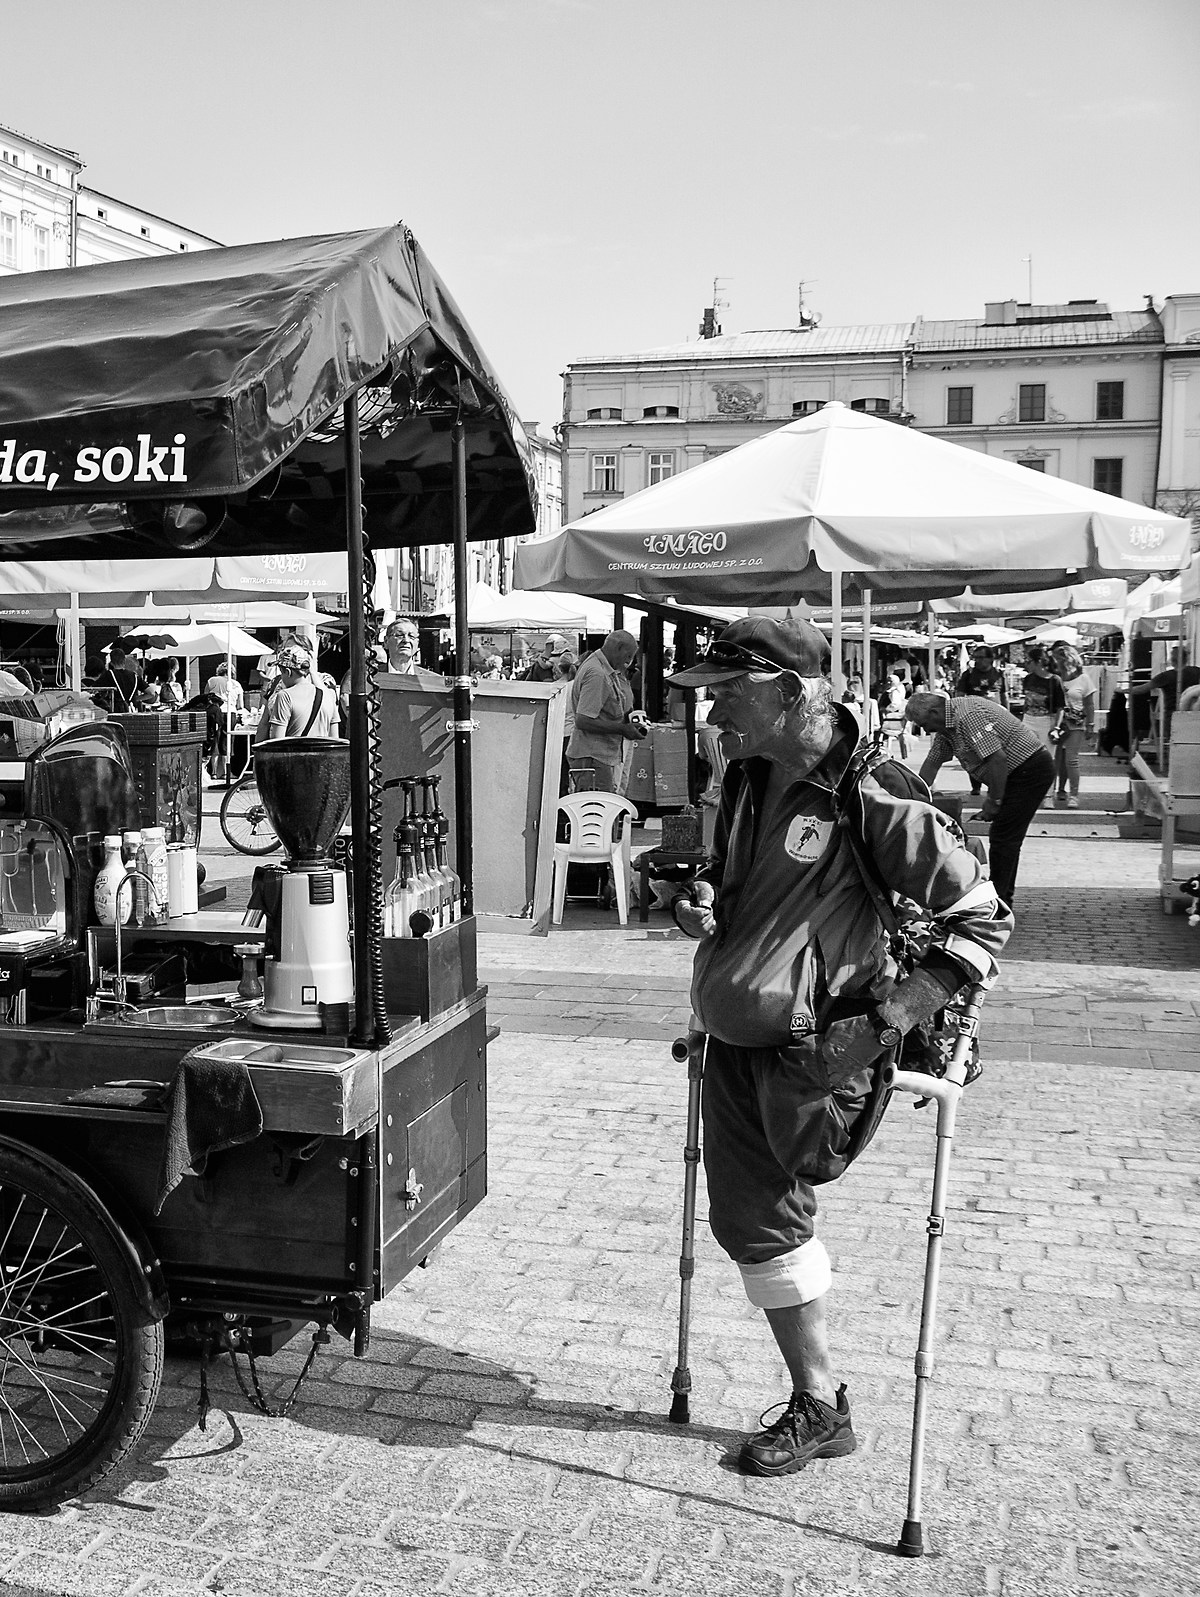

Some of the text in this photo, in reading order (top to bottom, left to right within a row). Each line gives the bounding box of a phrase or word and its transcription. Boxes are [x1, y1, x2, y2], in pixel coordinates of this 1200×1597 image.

[73, 433, 188, 484] soki
[643, 530, 727, 557] IMAGO
[608, 562, 647, 571] CENTRUM
[649, 562, 681, 570] SZTUKI
[683, 560, 723, 570] LUDOWEJ
[724, 559, 737, 568] SP.
